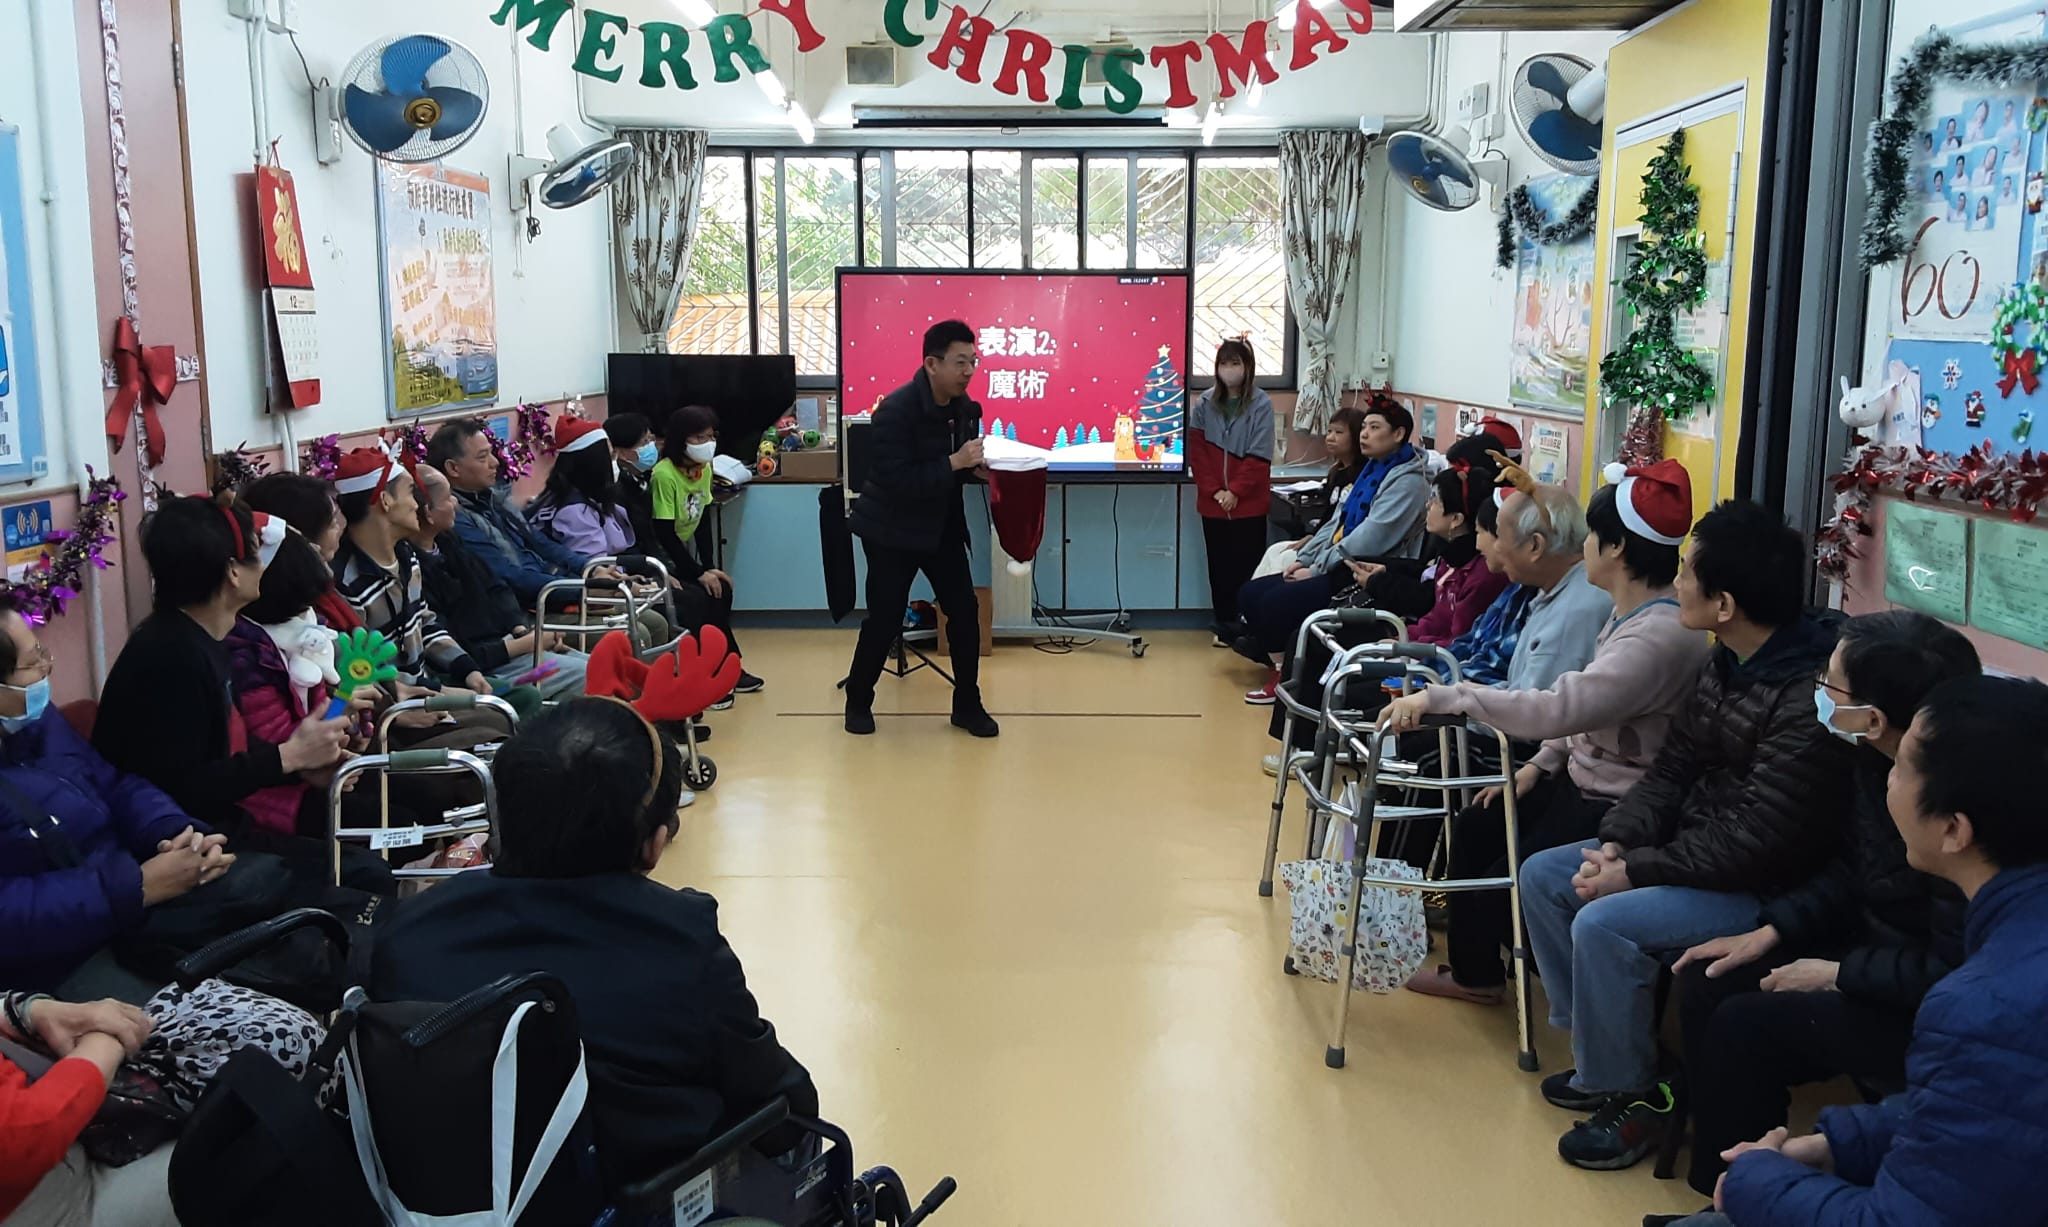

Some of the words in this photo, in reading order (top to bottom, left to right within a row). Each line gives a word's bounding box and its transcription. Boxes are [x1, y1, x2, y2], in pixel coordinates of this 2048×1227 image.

[489, 0, 826, 90] MERRY
[1901, 216, 1980, 325] 60
[977, 325, 1057, 357] 表演2:
[987, 368, 1050, 399] 魔術
